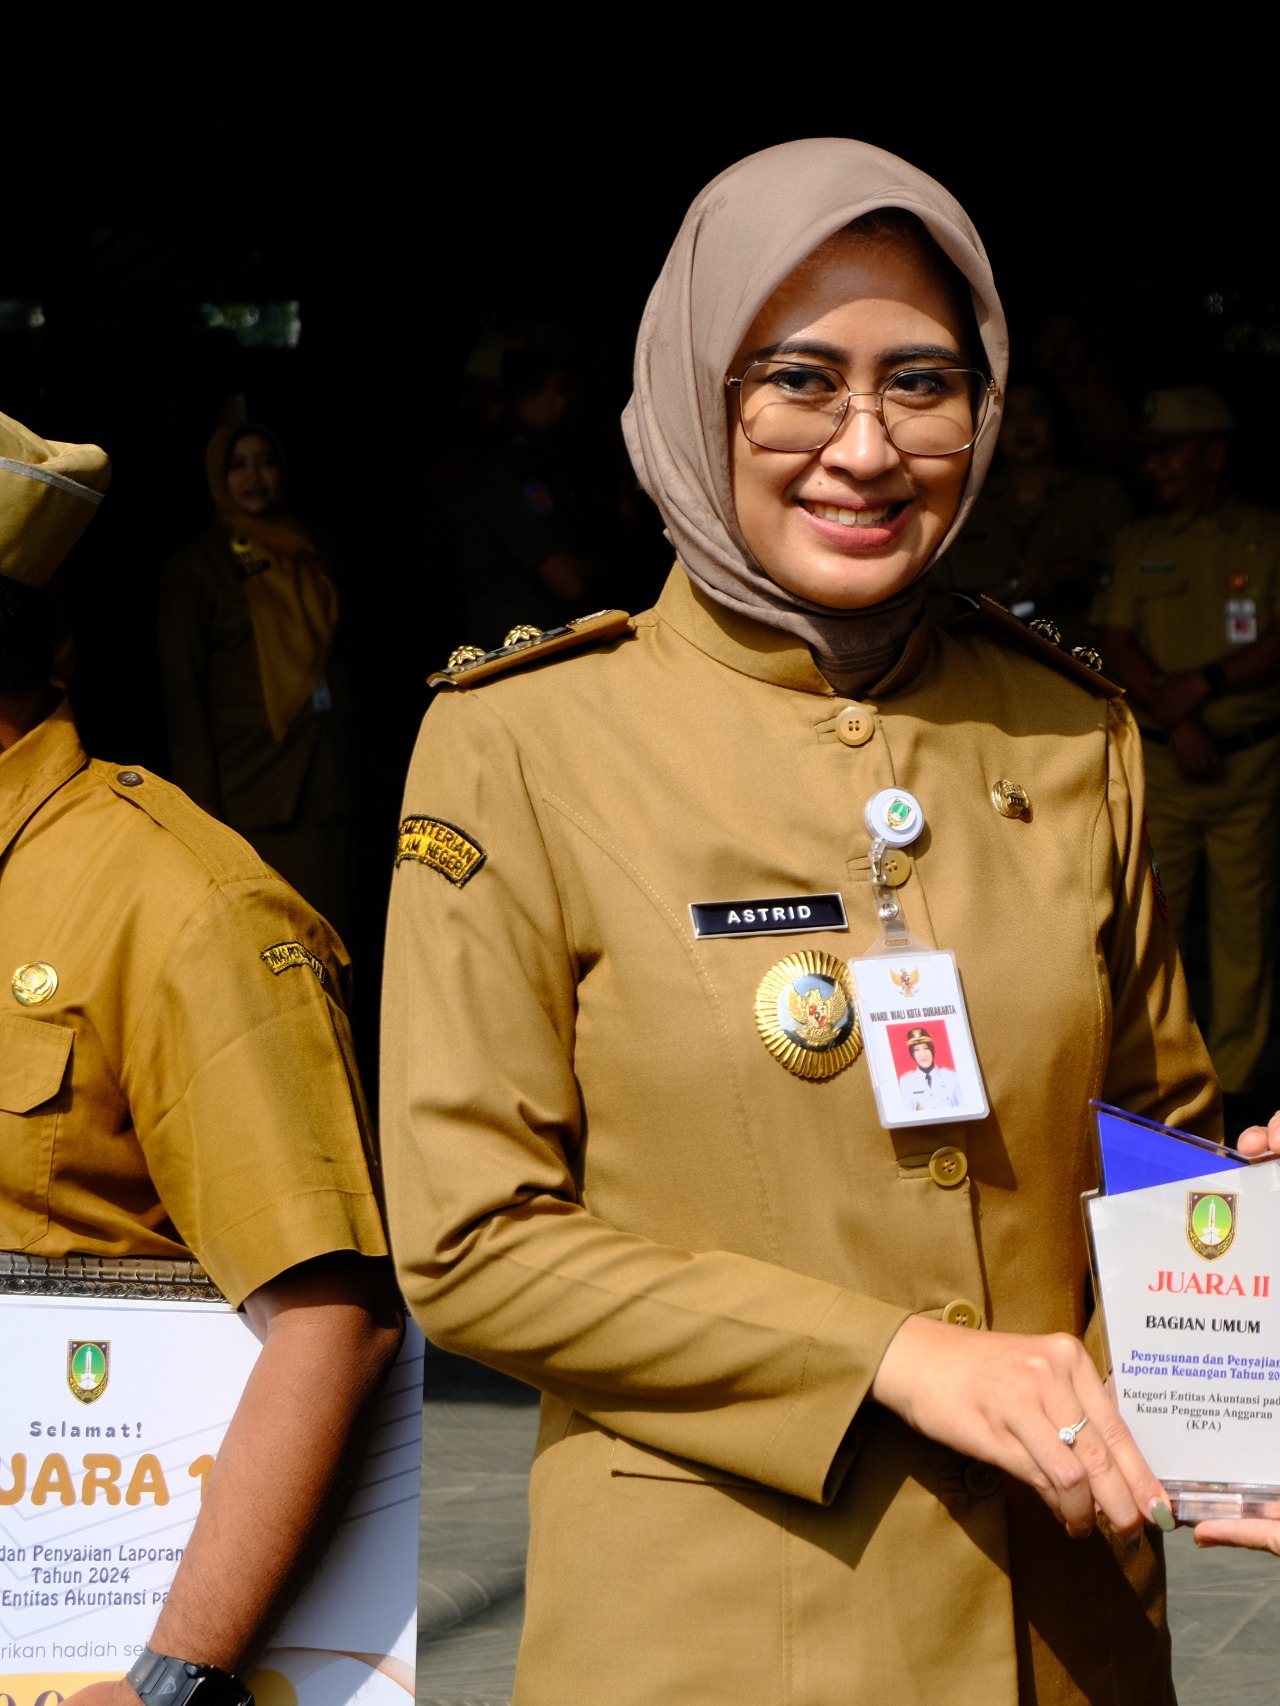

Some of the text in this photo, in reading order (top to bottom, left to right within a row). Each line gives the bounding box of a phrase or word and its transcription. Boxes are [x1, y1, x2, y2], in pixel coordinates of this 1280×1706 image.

[402, 820, 478, 864] MENTERIAN
[727, 905, 811, 925] ASTRID
[870, 1005, 957, 1022] WAKIL WALI KOTA SURAKARTA
[1148, 1270, 1270, 1297] JUARA II
[1146, 1315, 1261, 1334] BAGIAN UMUM
[1131, 1350, 1200, 1364] Penyusunan
[1203, 1353, 1224, 1365] dan
[1121, 1363, 1169, 1377] Laporan
[1171, 1365, 1228, 1380] Keuangan
[1230, 1368, 1265, 1380] Tahun
[1123, 1388, 1168, 1402] Kategori
[1170, 1391, 1206, 1402] Entitas
[1209, 1393, 1260, 1405] Akuntansi
[1136, 1403, 1273, 1420] Kuasa Pengguna Anggaran
[29, 1420, 143, 1439] Selamat!
[1186, 1419, 1222, 1432] (KPA)
[0, 1452, 170, 1507] UARA
[33, 1545, 112, 1562] Penyajian
[118, 1545, 185, 1562] Laporan
[31, 1567, 131, 1584] Tahun 2024
[2, 1589, 59, 1607] Entitas
[64, 1589, 147, 1606] Akuntansi
[1, 1642, 47, 1660] rikan
[52, 1641, 118, 1658] hadiah
